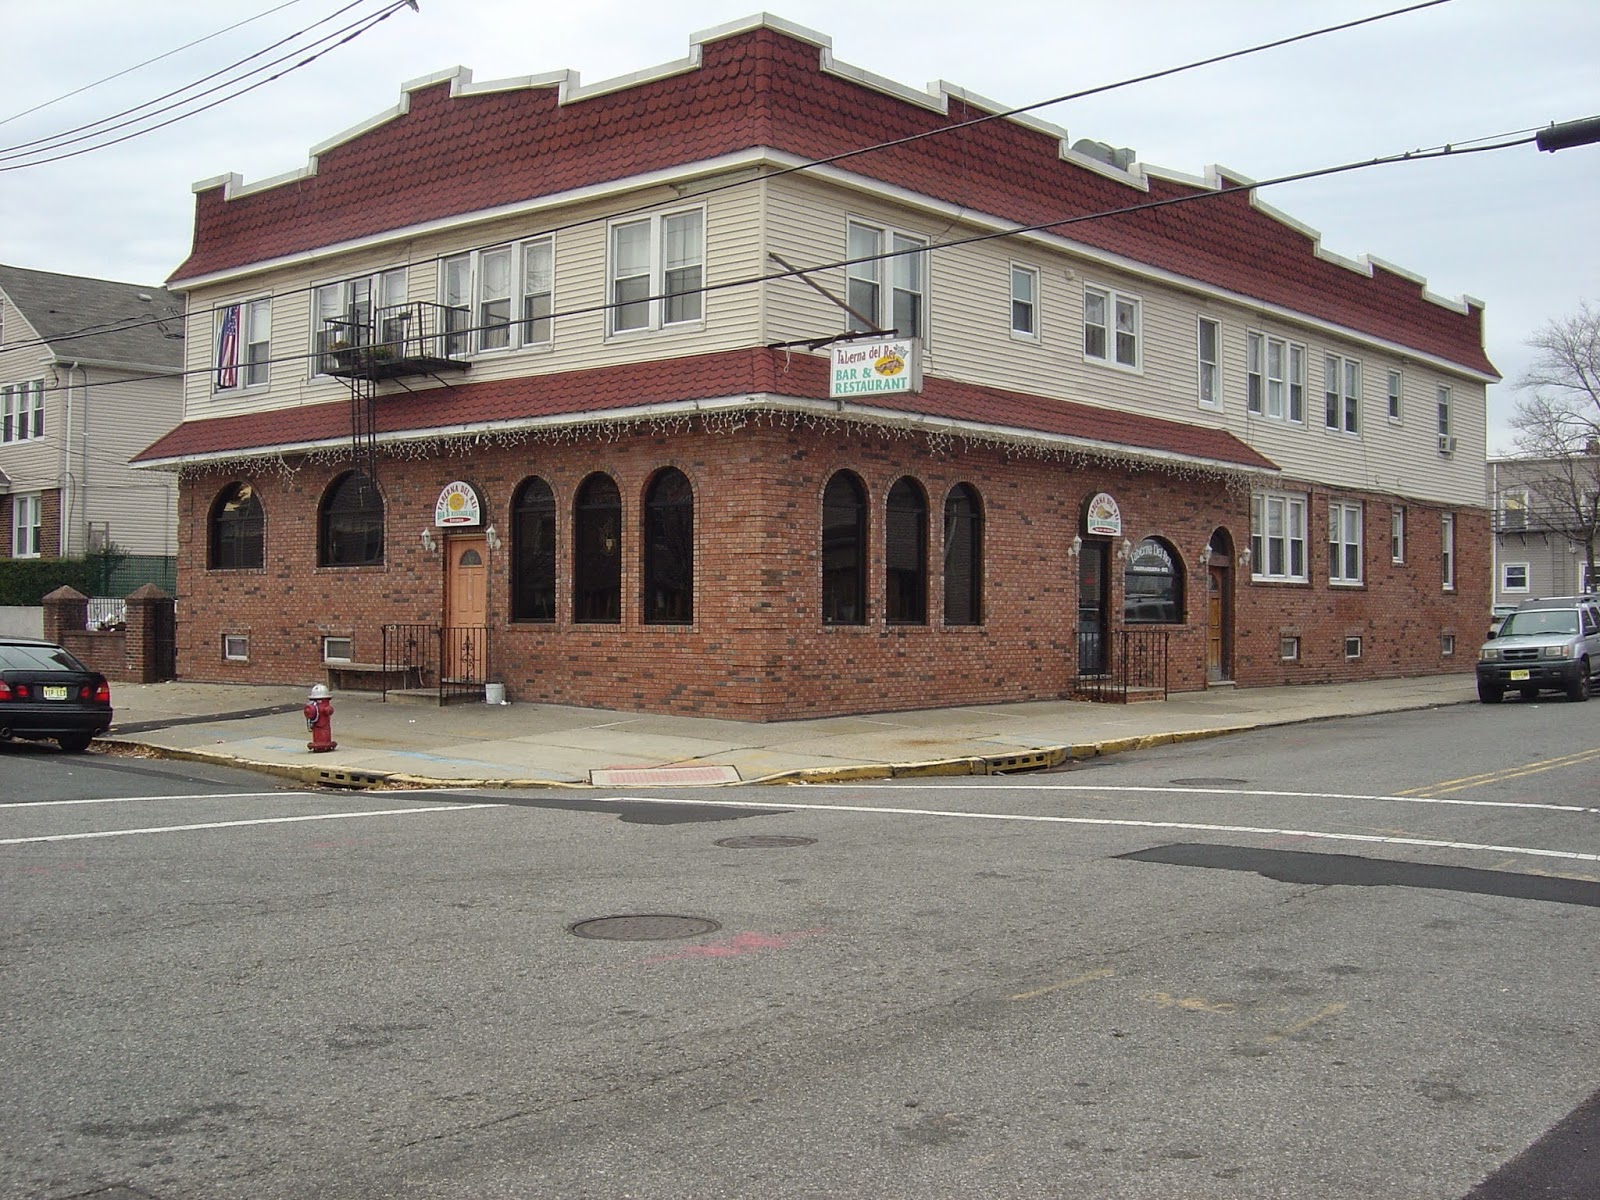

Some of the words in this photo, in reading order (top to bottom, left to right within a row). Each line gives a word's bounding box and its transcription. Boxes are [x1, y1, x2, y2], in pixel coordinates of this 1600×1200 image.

[869, 345, 881, 359] del
[836, 368, 857, 381] BAR
[862, 367, 872, 378] &
[835, 377, 907, 394] RESTAURANT
[438, 485, 459, 511] TABERNA
[460, 485, 470, 497] DEL
[469, 495, 478, 509] REI
